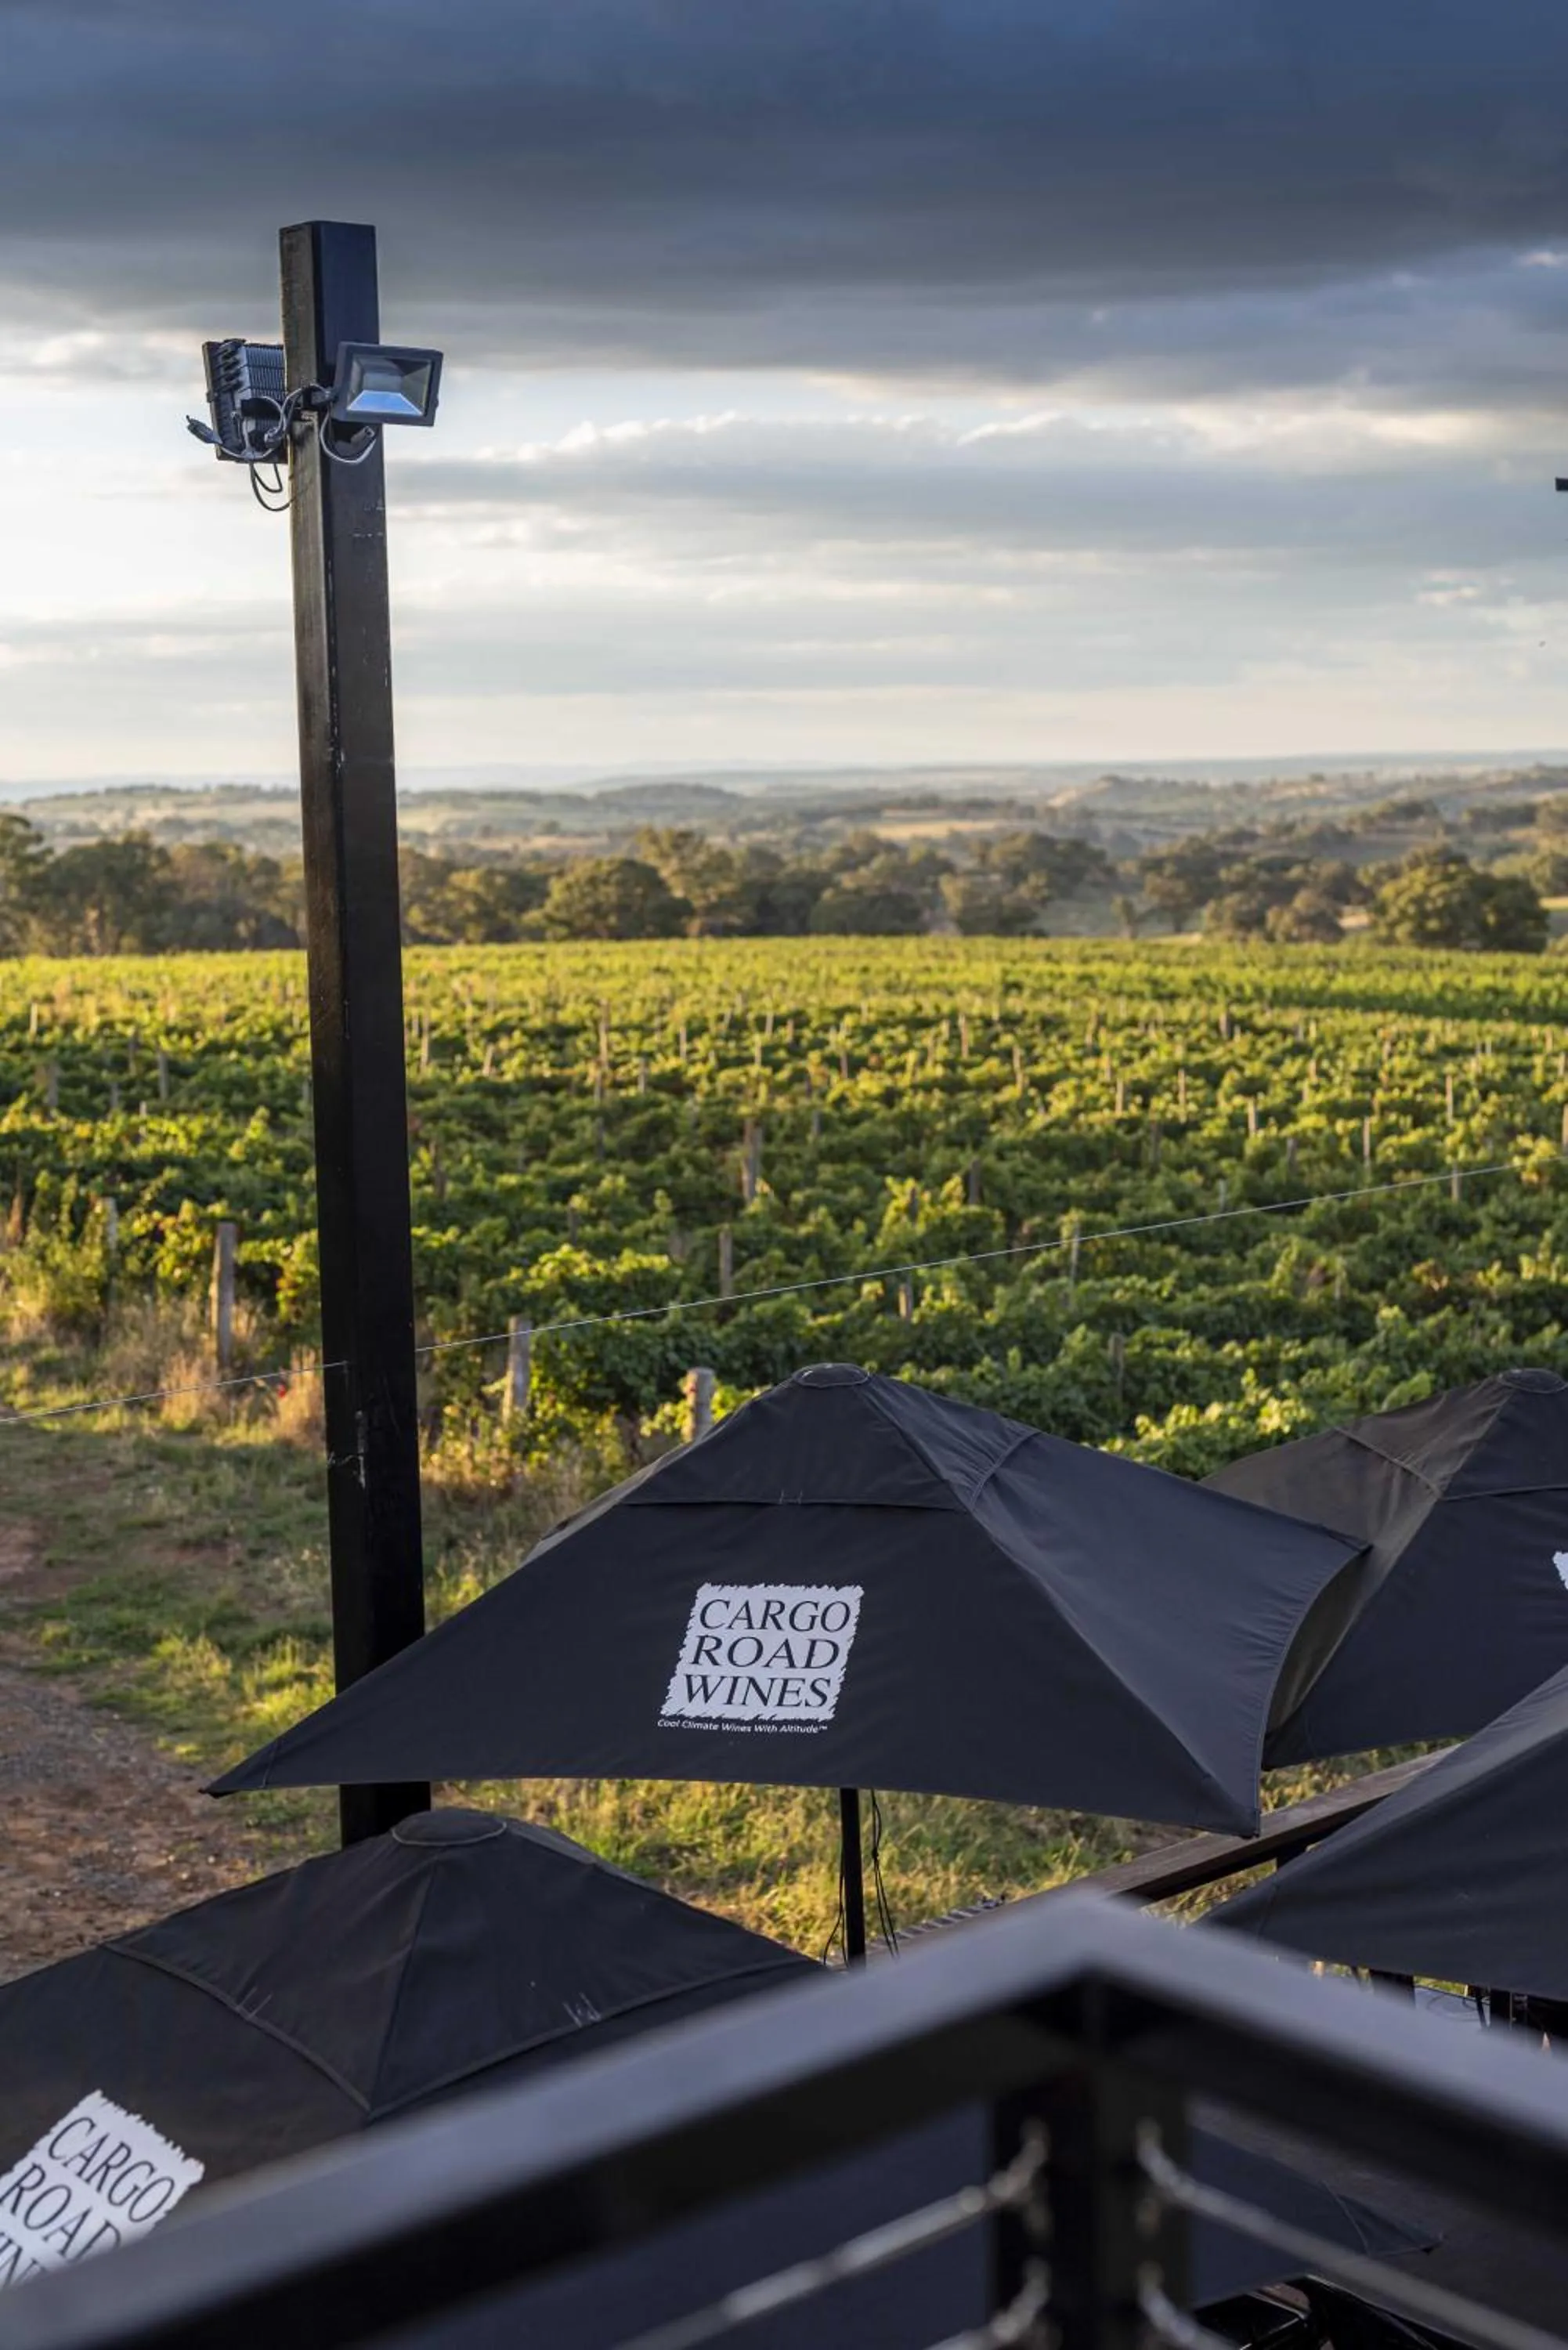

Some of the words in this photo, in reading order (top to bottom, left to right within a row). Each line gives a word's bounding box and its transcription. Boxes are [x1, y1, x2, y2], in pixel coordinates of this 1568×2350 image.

[699, 1599, 851, 1632] CARGO
[688, 1634, 840, 1669] ROAD
[683, 1673, 832, 1708] WINES
[657, 1719, 681, 1728] Cool
[681, 1720, 720, 1730] Climate
[721, 1723, 752, 1732] Wines
[753, 1724, 778, 1733] With
[48, 2117, 175, 2223] CARGO
